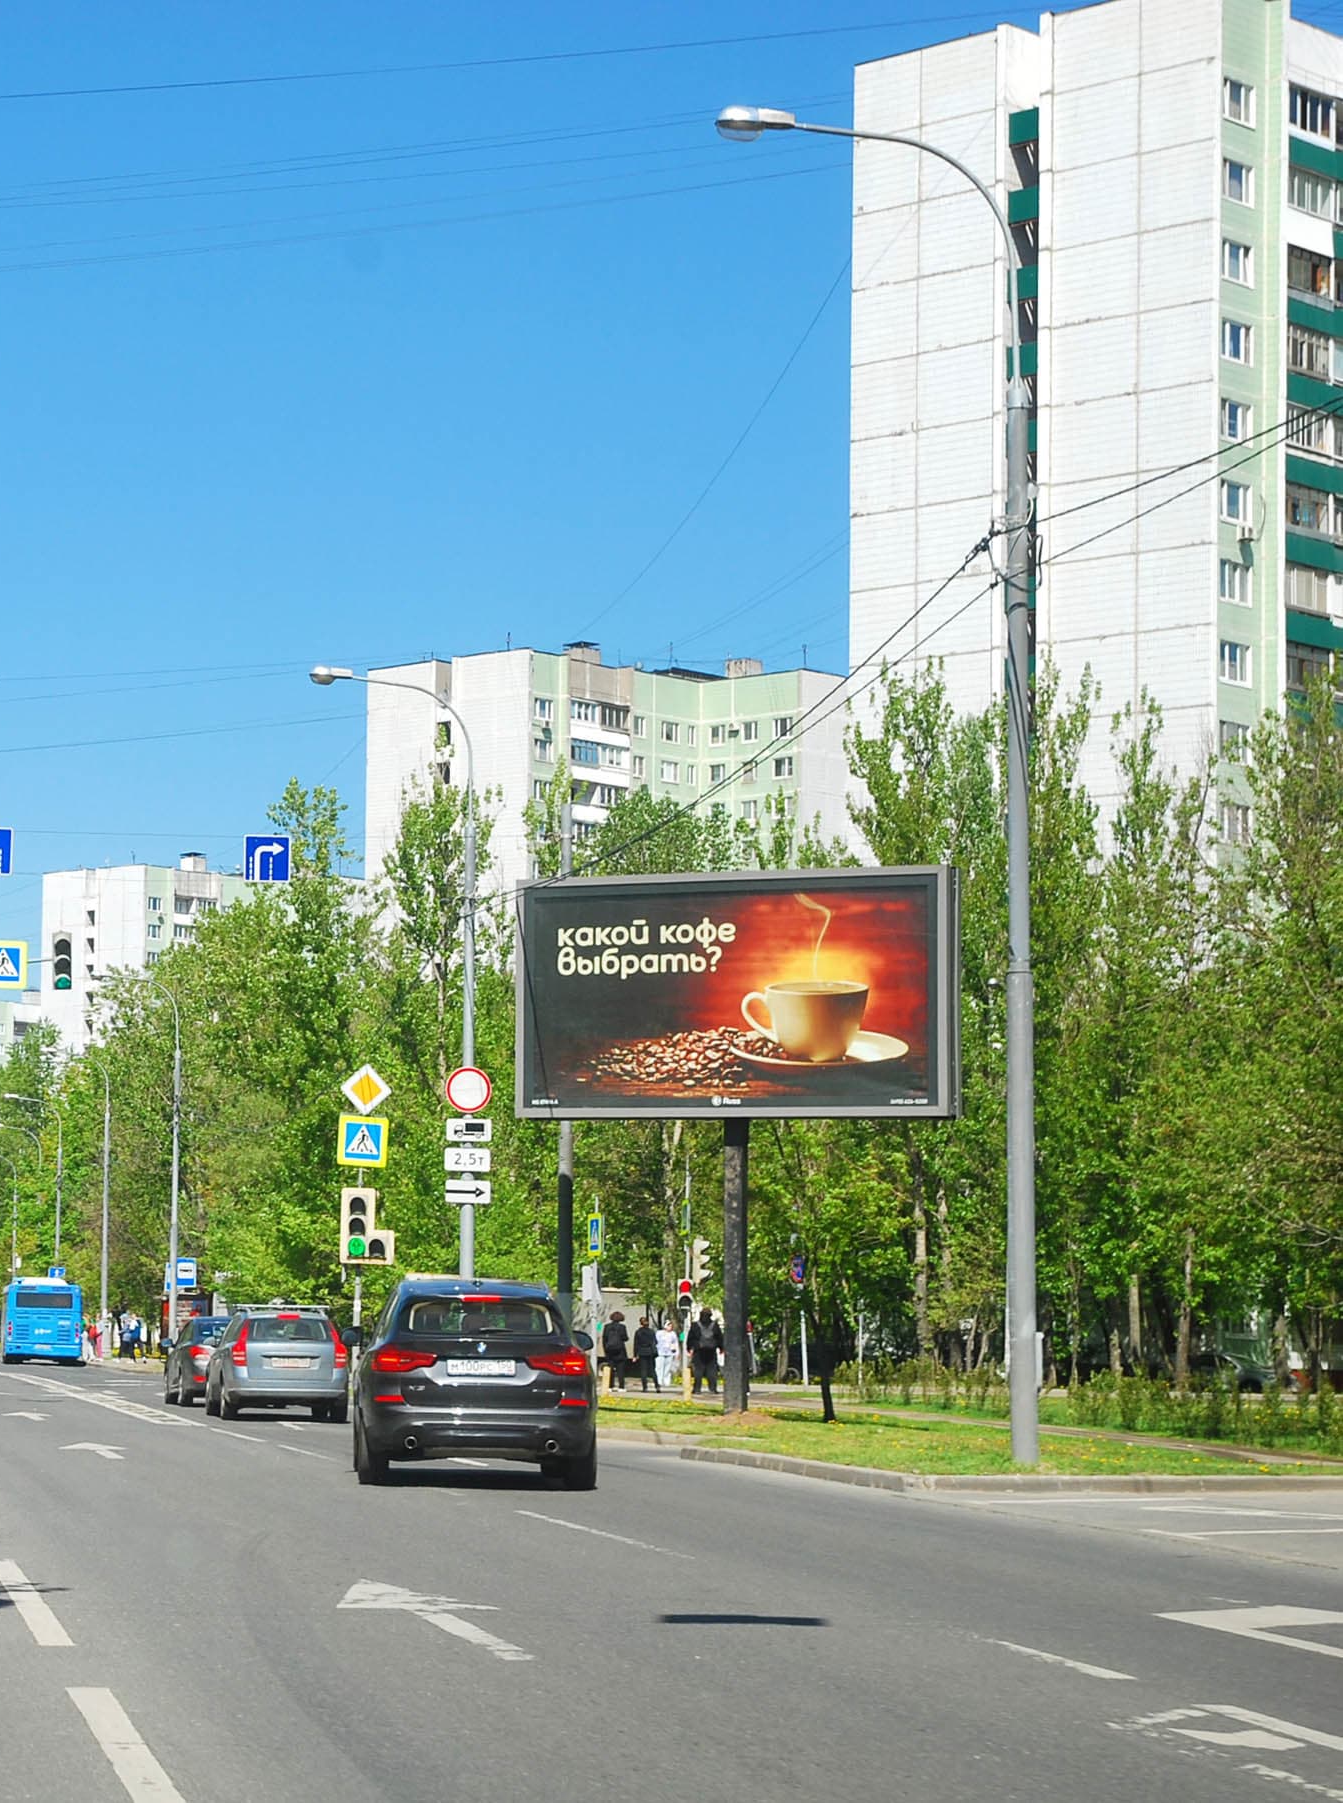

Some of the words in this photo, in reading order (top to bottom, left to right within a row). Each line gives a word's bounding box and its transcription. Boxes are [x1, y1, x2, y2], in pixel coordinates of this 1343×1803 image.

[557, 919, 650, 947] какой
[659, 917, 737, 948] кофе
[557, 946, 723, 980] выбрать?
